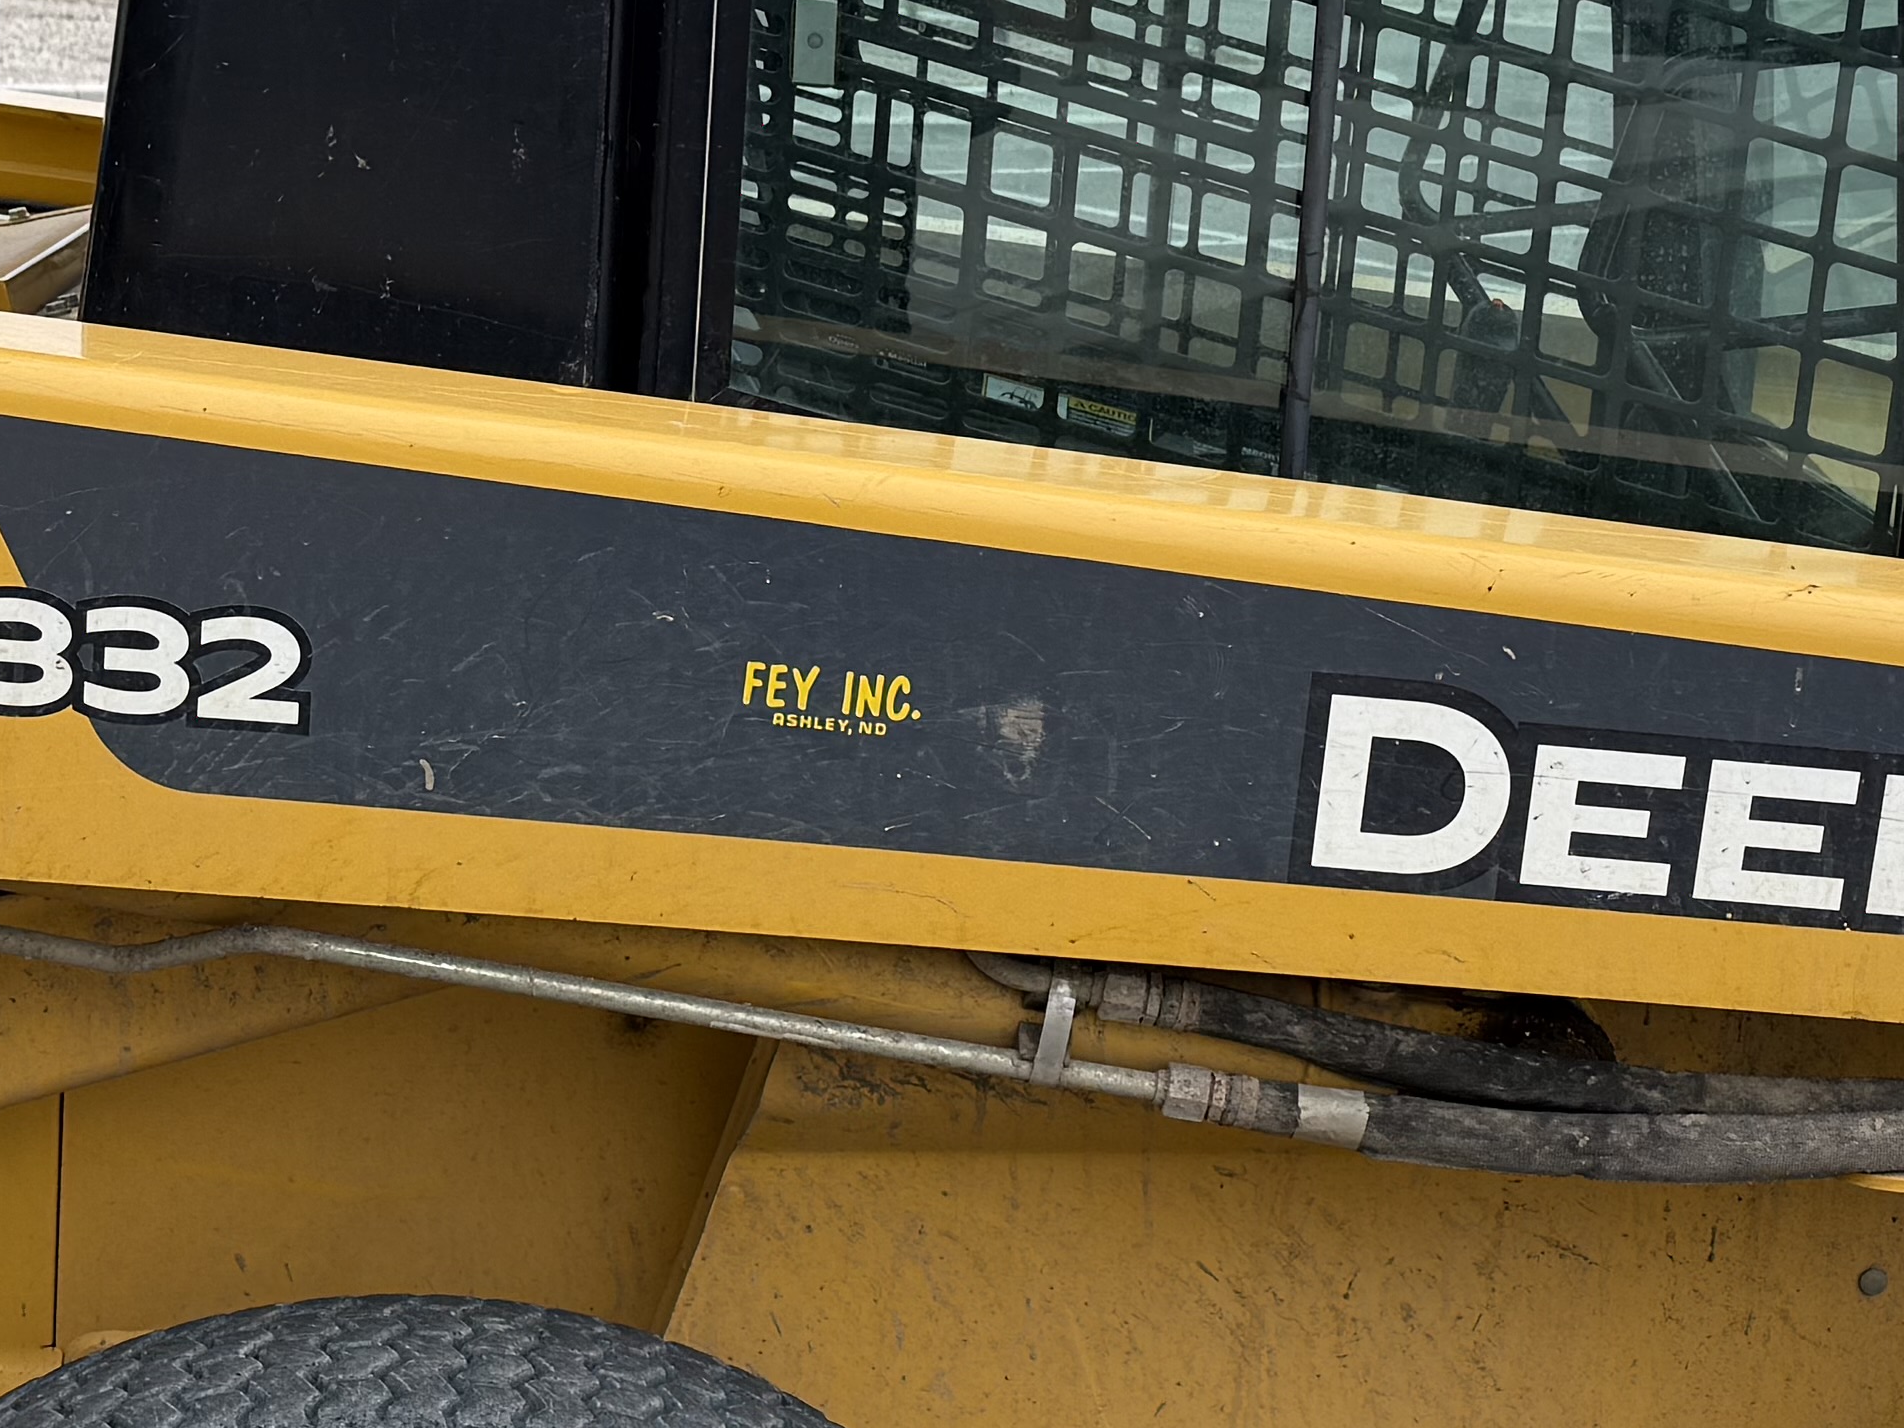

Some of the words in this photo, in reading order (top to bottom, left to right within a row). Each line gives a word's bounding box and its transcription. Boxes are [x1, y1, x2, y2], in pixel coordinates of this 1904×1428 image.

[742, 661, 820, 710] FEY
[842, 671, 921, 721] INC.
[773, 712, 852, 736] ASHLEY,
[858, 721, 887, 736] ND
